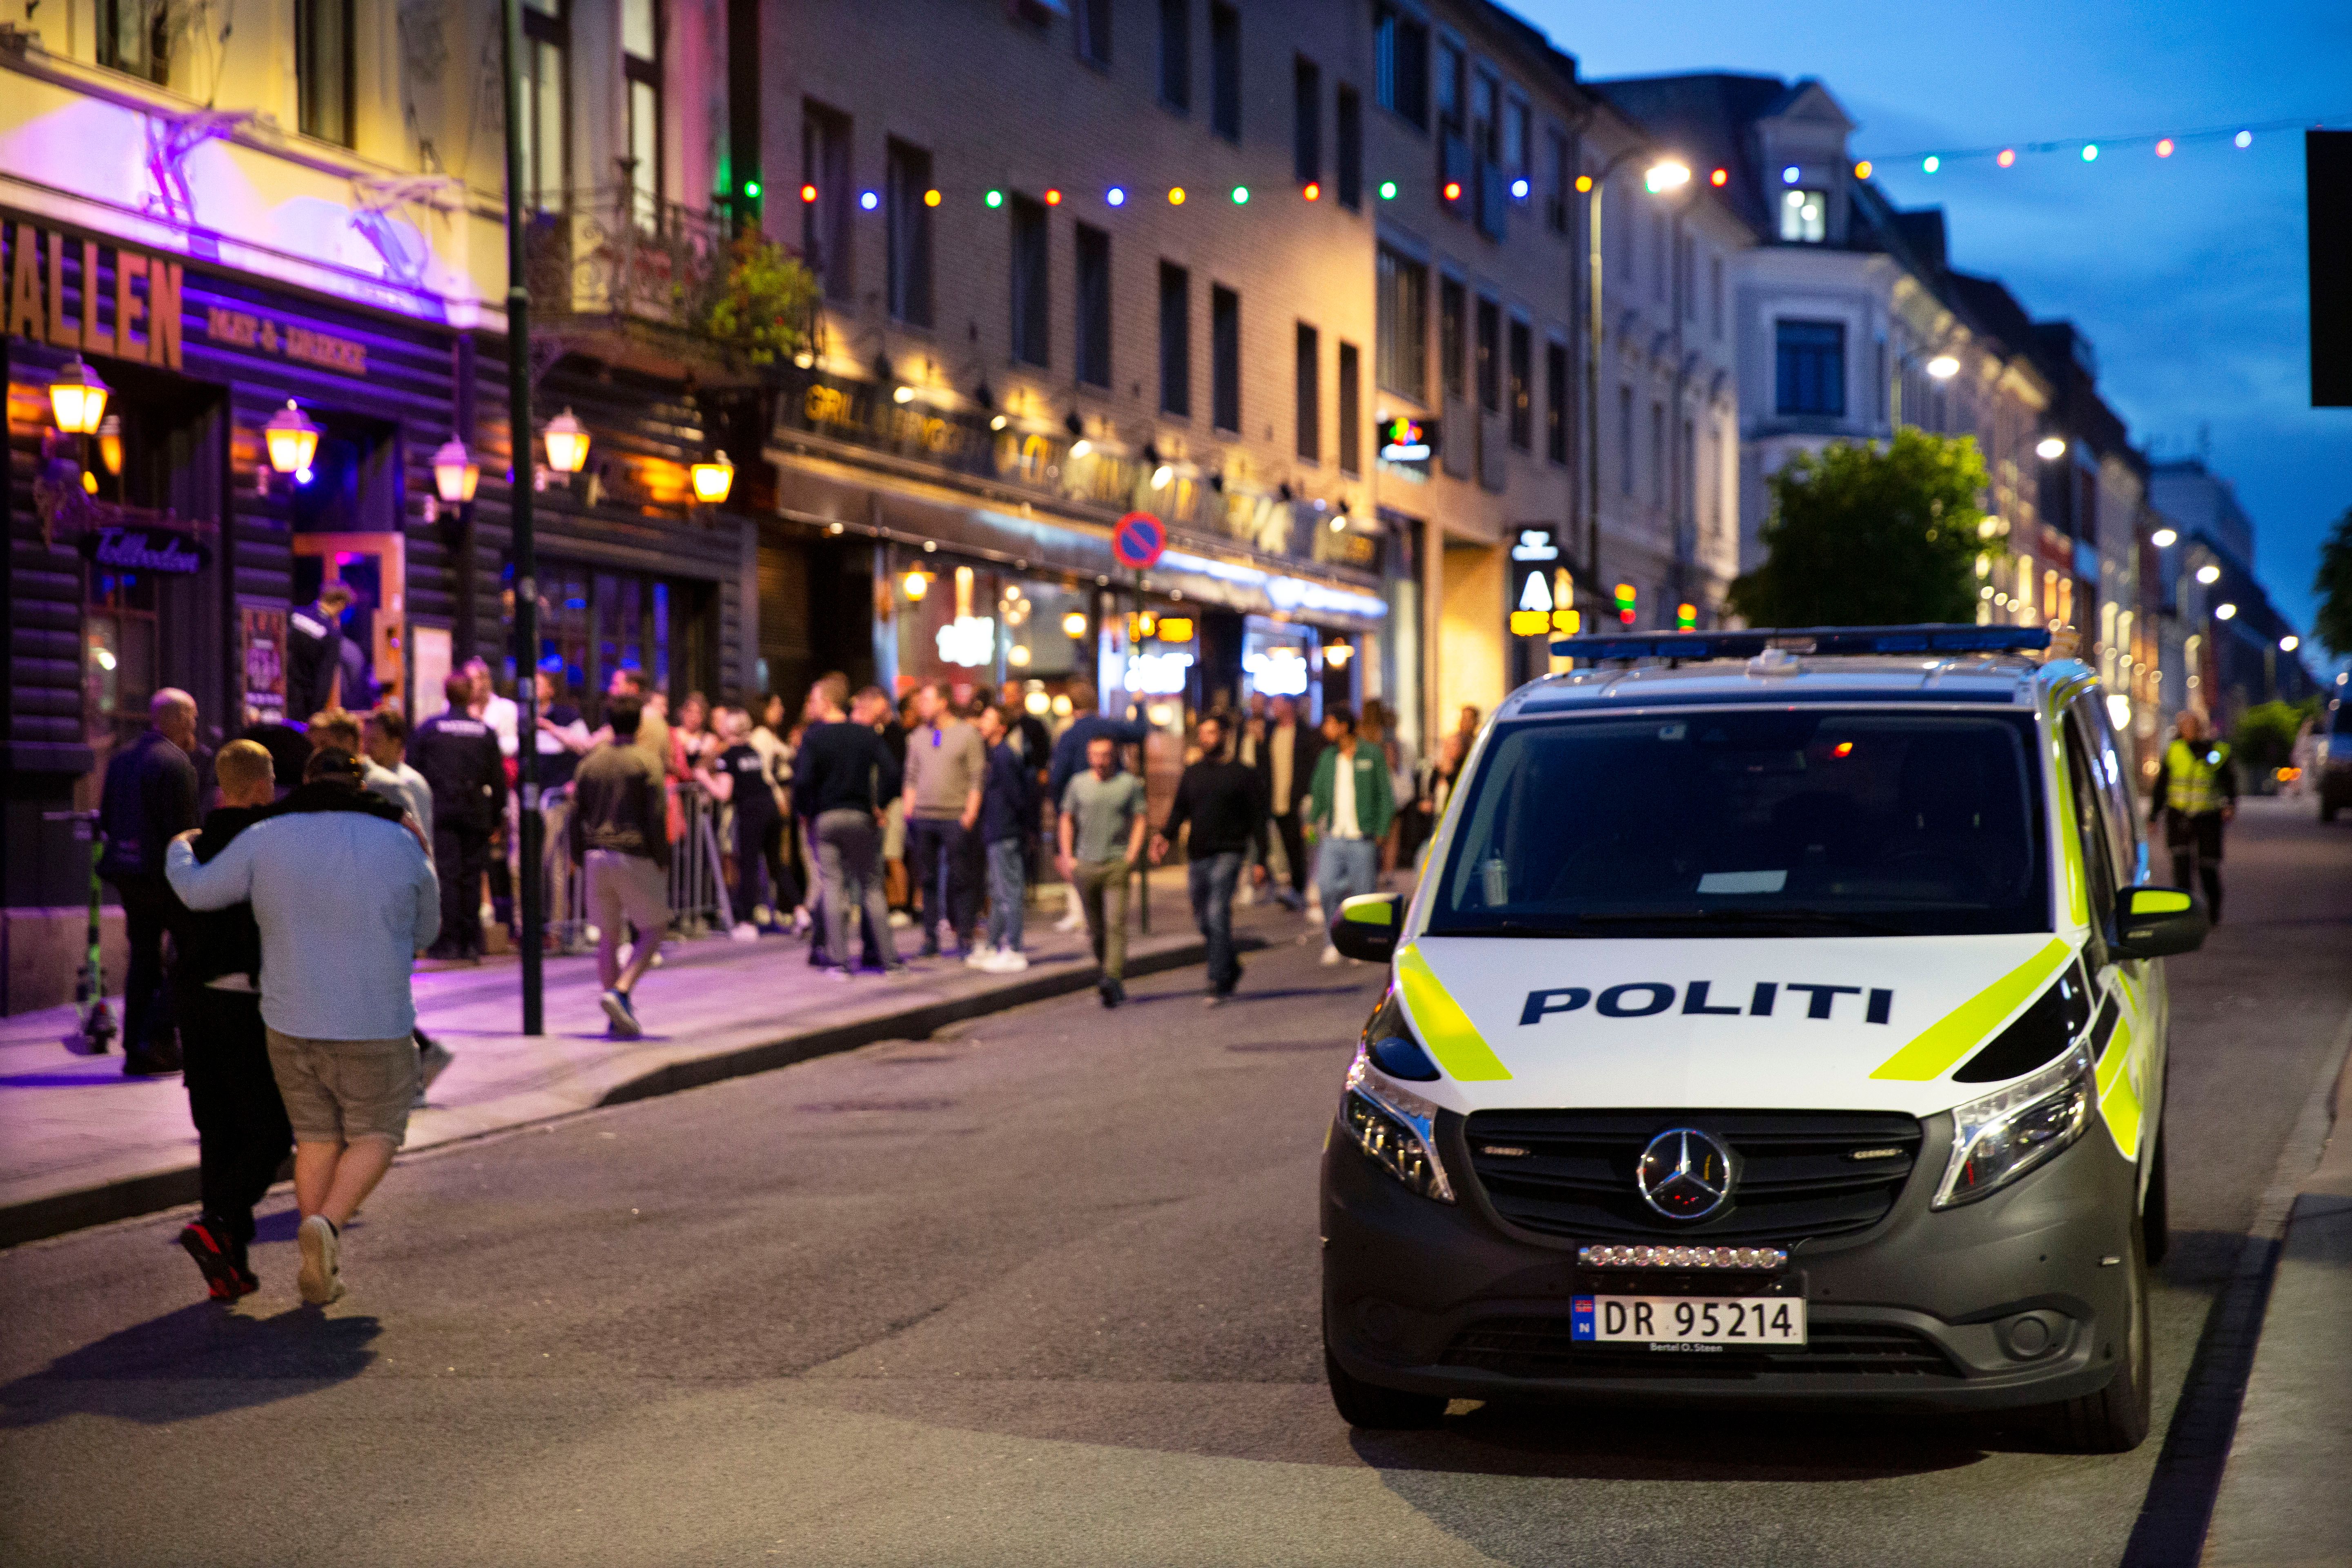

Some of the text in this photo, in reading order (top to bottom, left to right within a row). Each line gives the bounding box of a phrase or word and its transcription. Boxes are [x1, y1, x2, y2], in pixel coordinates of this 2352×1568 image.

[0, 218, 183, 371] ALLEN
[1519, 980, 1895, 1026] POLITI
[1579, 1323, 1590, 1333] N
[1605, 1301, 1792, 1337] DR 95214
[1649, 1342, 1680, 1352] Bertel
[1694, 1343, 1724, 1352] Steen
